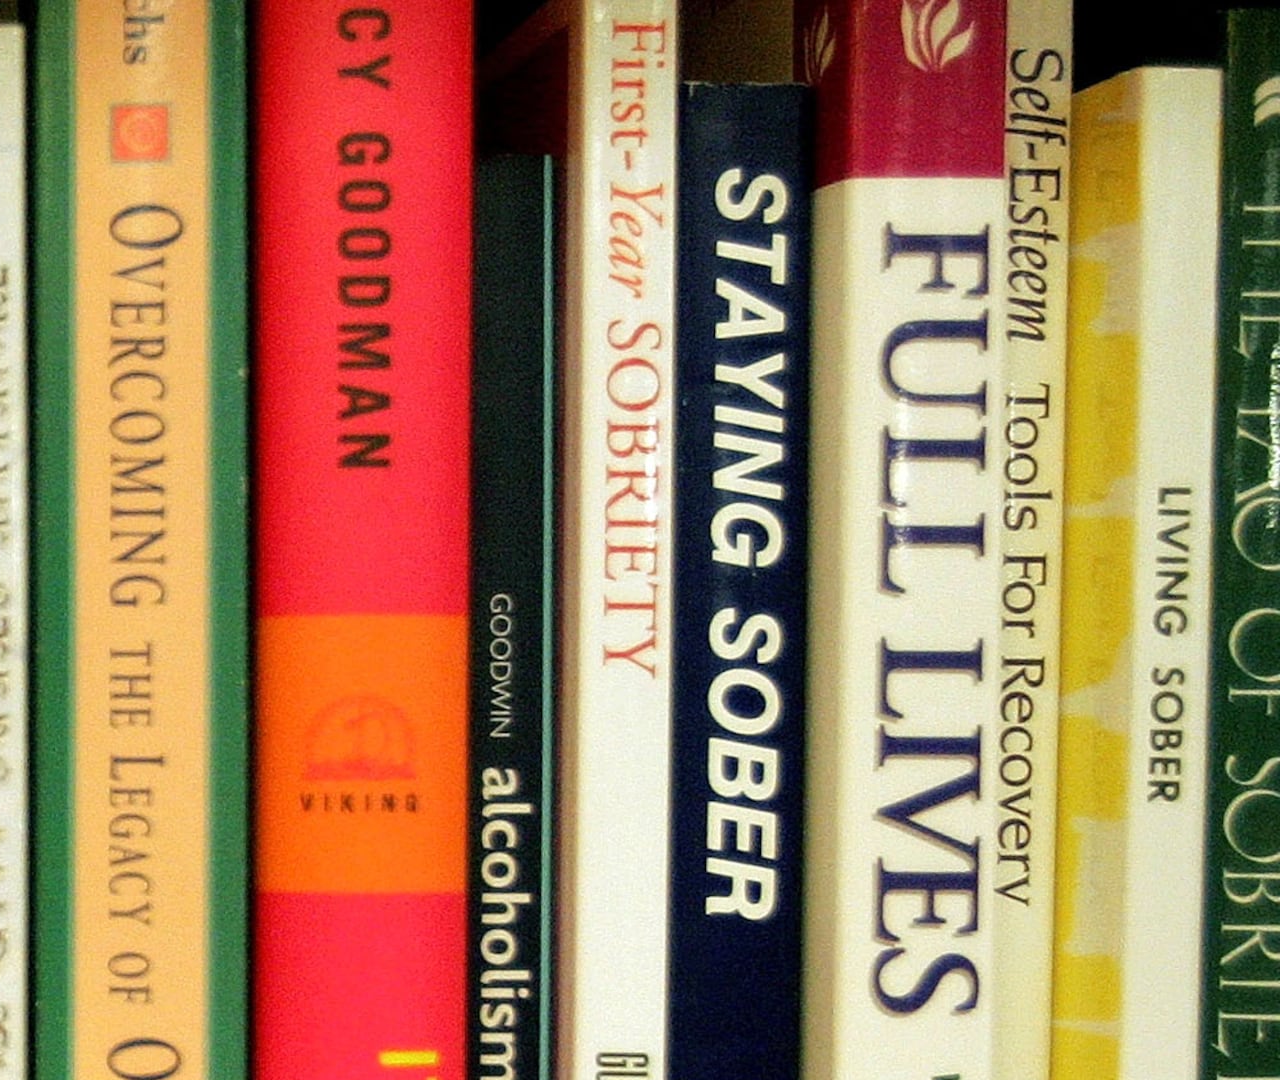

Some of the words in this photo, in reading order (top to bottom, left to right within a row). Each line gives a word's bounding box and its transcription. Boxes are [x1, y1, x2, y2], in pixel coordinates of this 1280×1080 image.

[609, 19, 667, 299] First-Year
[1006, 47, 1063, 342] Self-Esteem
[108, 203, 184, 611] OVERCOMING
[336, 130, 393, 471] GOODMAN
[709, 168, 786, 571] STAYING
[880, 222, 992, 599] FULL
[601, 319, 663, 681] SOBRIETY
[1003, 381, 1051, 533] Tools
[1154, 485, 1191, 638] LIVING
[108, 641, 156, 729] THE
[489, 593, 512, 738] GOODWIN
[1001, 552, 1049, 640] For
[107, 752, 165, 928] LEGACY
[300, 793, 420, 814] VIKING
[704, 607, 783, 923] SOBER
[872, 634, 985, 1018] LIVES
[996, 656, 1048, 908] Recovery
[1146, 666, 1186, 804] SOBER
[107, 950, 152, 1006] OF
